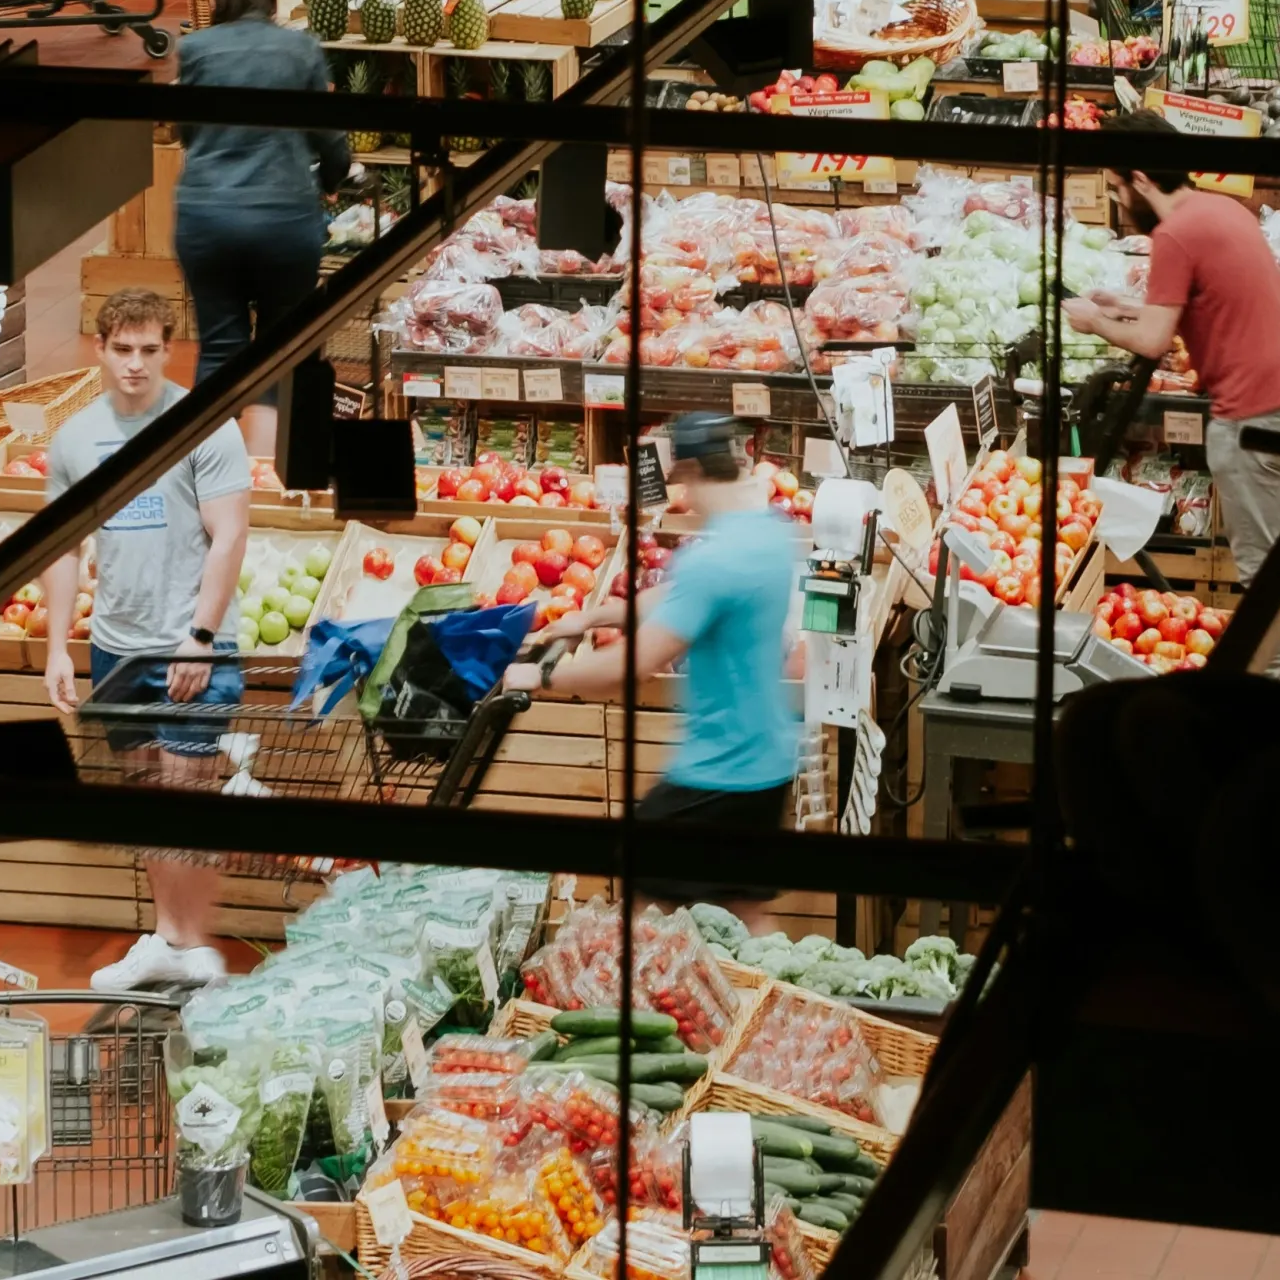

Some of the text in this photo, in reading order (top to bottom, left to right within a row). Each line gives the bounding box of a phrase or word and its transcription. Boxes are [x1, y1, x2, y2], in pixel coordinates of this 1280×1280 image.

[807, 106, 853, 117] Wegmans
[1179, 110, 1224, 127] Wegmans
[1184, 121, 1217, 135] Apples
